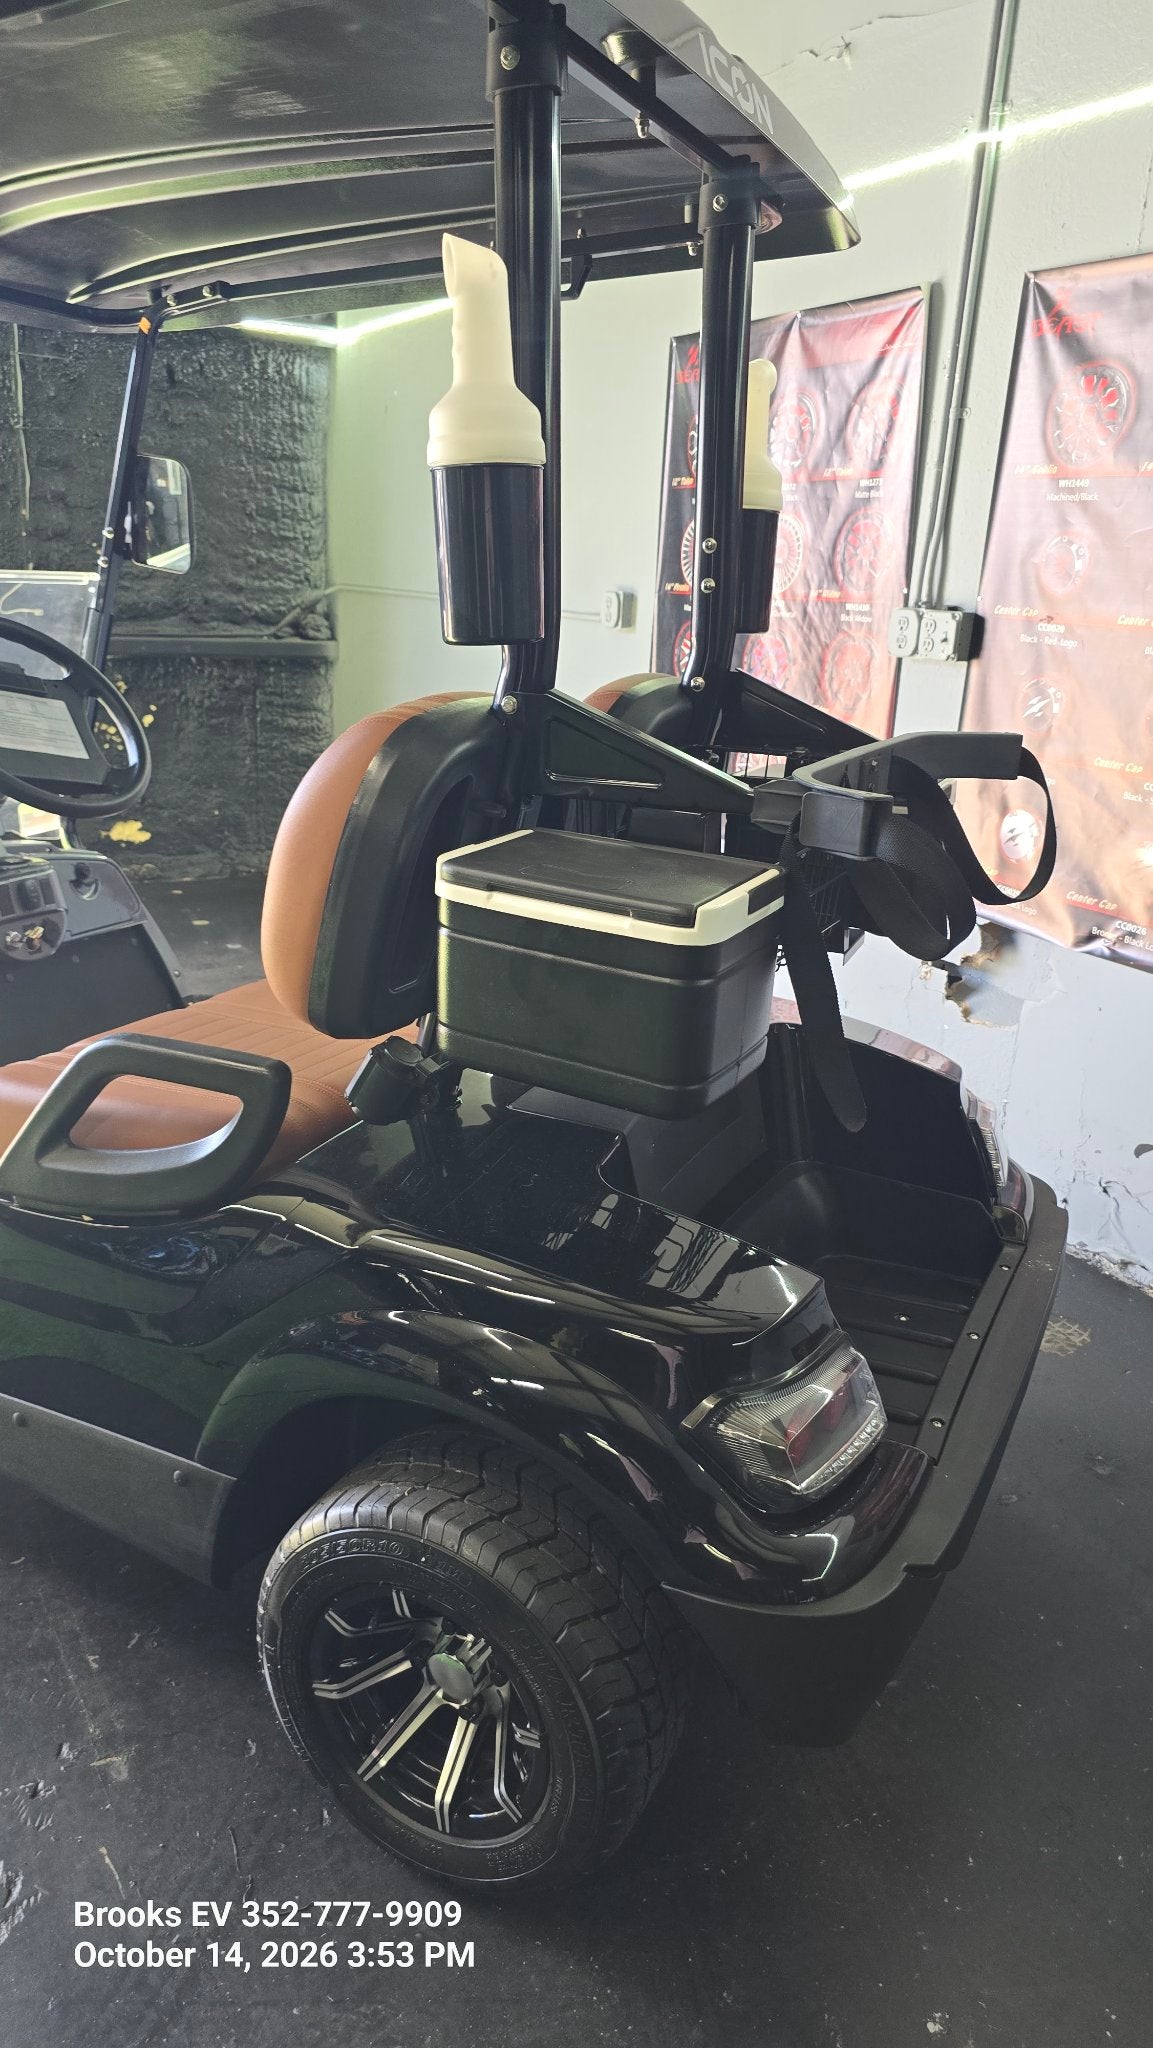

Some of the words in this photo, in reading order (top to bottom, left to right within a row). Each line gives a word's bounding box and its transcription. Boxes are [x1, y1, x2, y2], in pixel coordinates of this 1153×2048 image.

[698, 32, 773, 135] ICON
[994, 605, 1021, 616] Center
[1022, 607, 1039, 617] Cap
[1117, 615, 1150, 626] Center
[1019, 634, 1038, 644] Black
[1125, 763, 1143, 773] Cap
[1123, 792, 1143, 802] Black
[1066, 890, 1098, 905] Center
[1098, 899, 1118, 910] Cap
[1115, 920, 1147, 936] CC0026
[1124, 935, 1144, 948] Black
